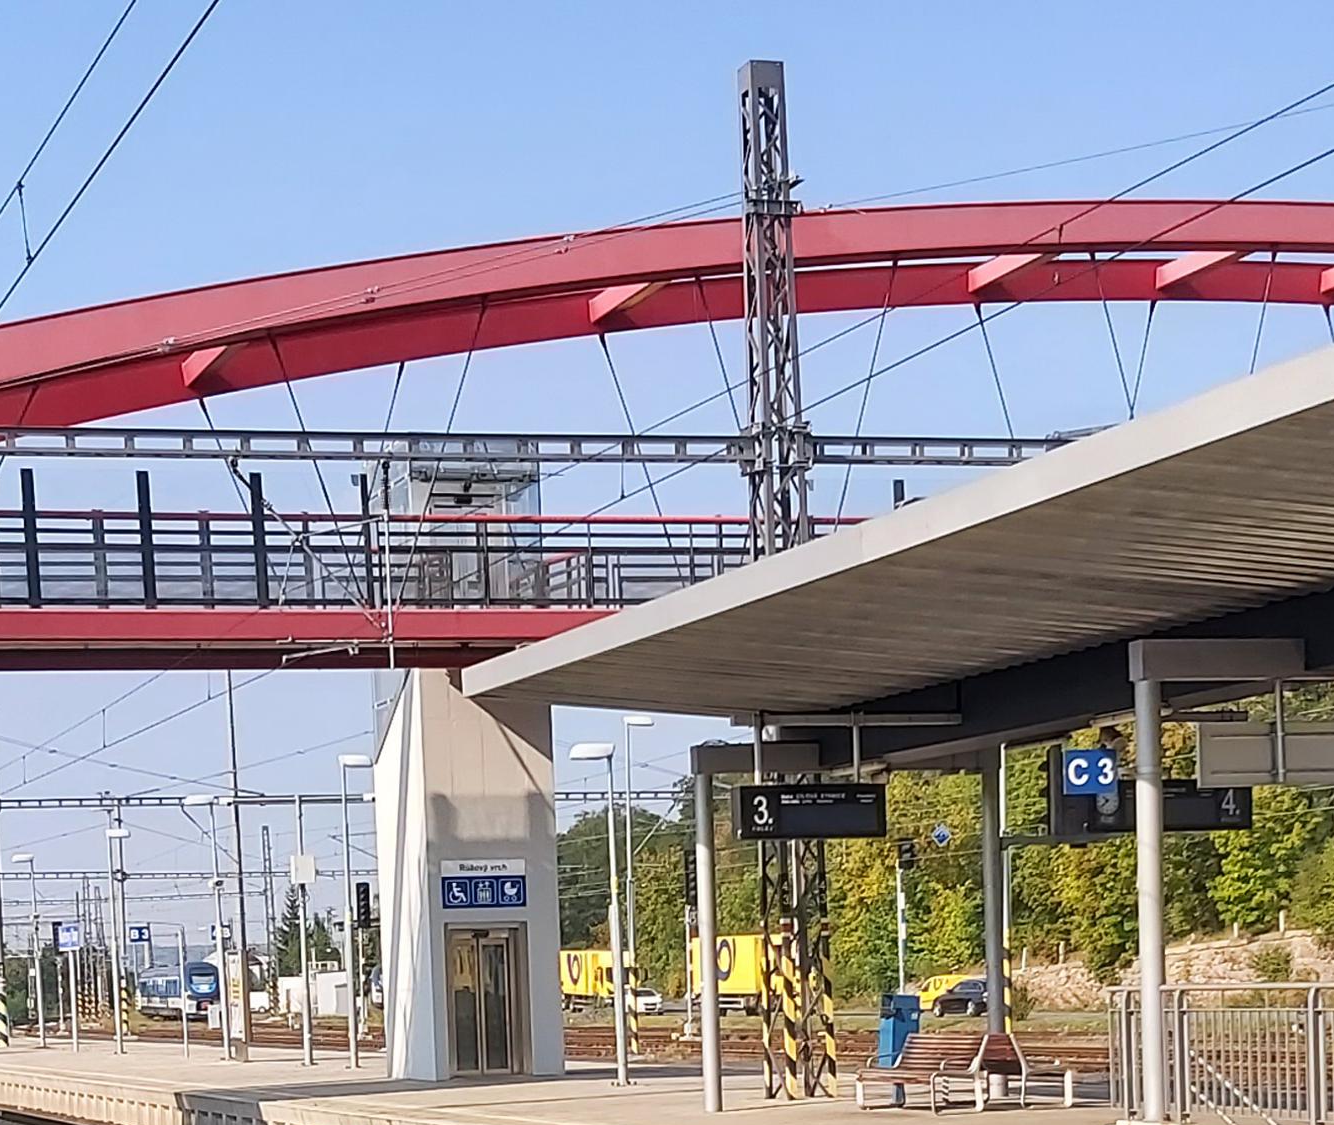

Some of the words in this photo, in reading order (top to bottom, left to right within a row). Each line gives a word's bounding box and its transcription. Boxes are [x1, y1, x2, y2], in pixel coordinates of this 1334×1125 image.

[1067, 758, 1089, 785] C
[1097, 757, 1114, 785] 3
[753, 795, 773, 825] 3.
